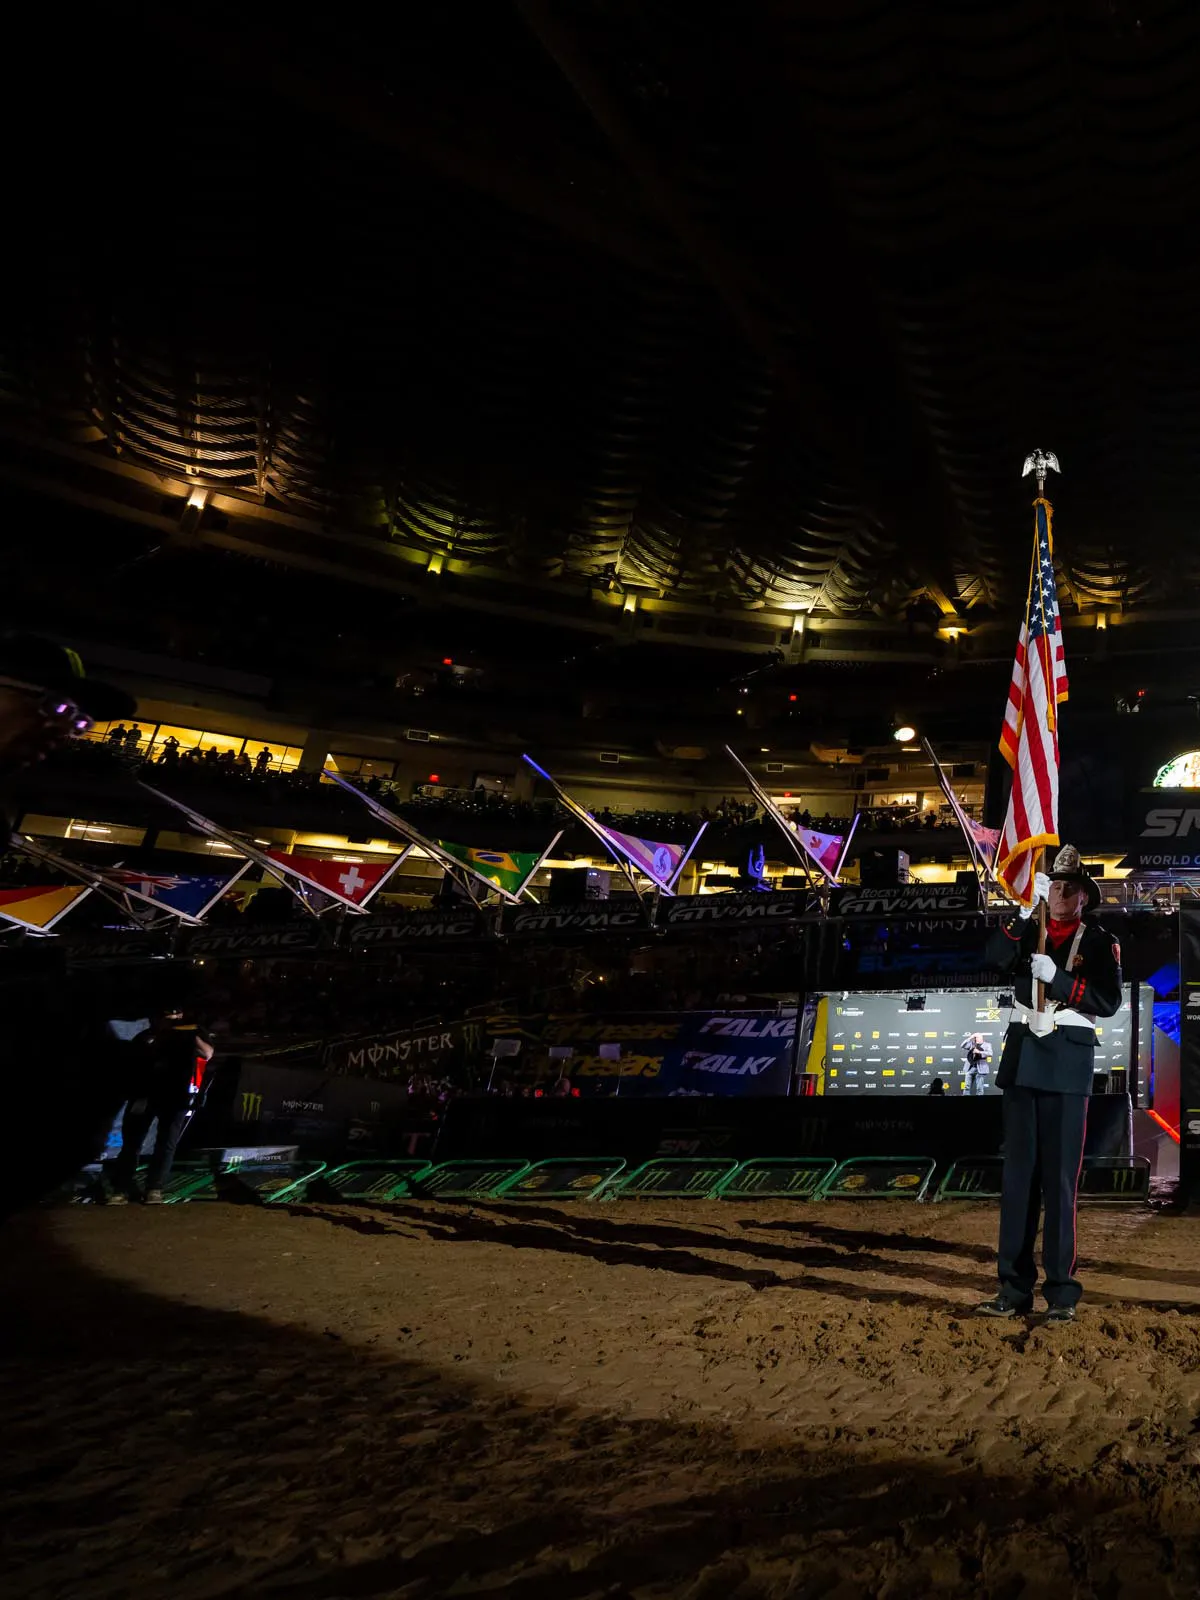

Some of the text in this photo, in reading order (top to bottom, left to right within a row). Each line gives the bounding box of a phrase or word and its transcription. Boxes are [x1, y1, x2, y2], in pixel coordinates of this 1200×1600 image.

[1140, 855, 1189, 865] WORLD
[860, 885, 969, 899] ROCKY MOUNTAIN
[700, 1017, 797, 1038] FALKE
[347, 1033, 455, 1069] MONSTER
[282, 1100, 325, 1112] MONSTER
